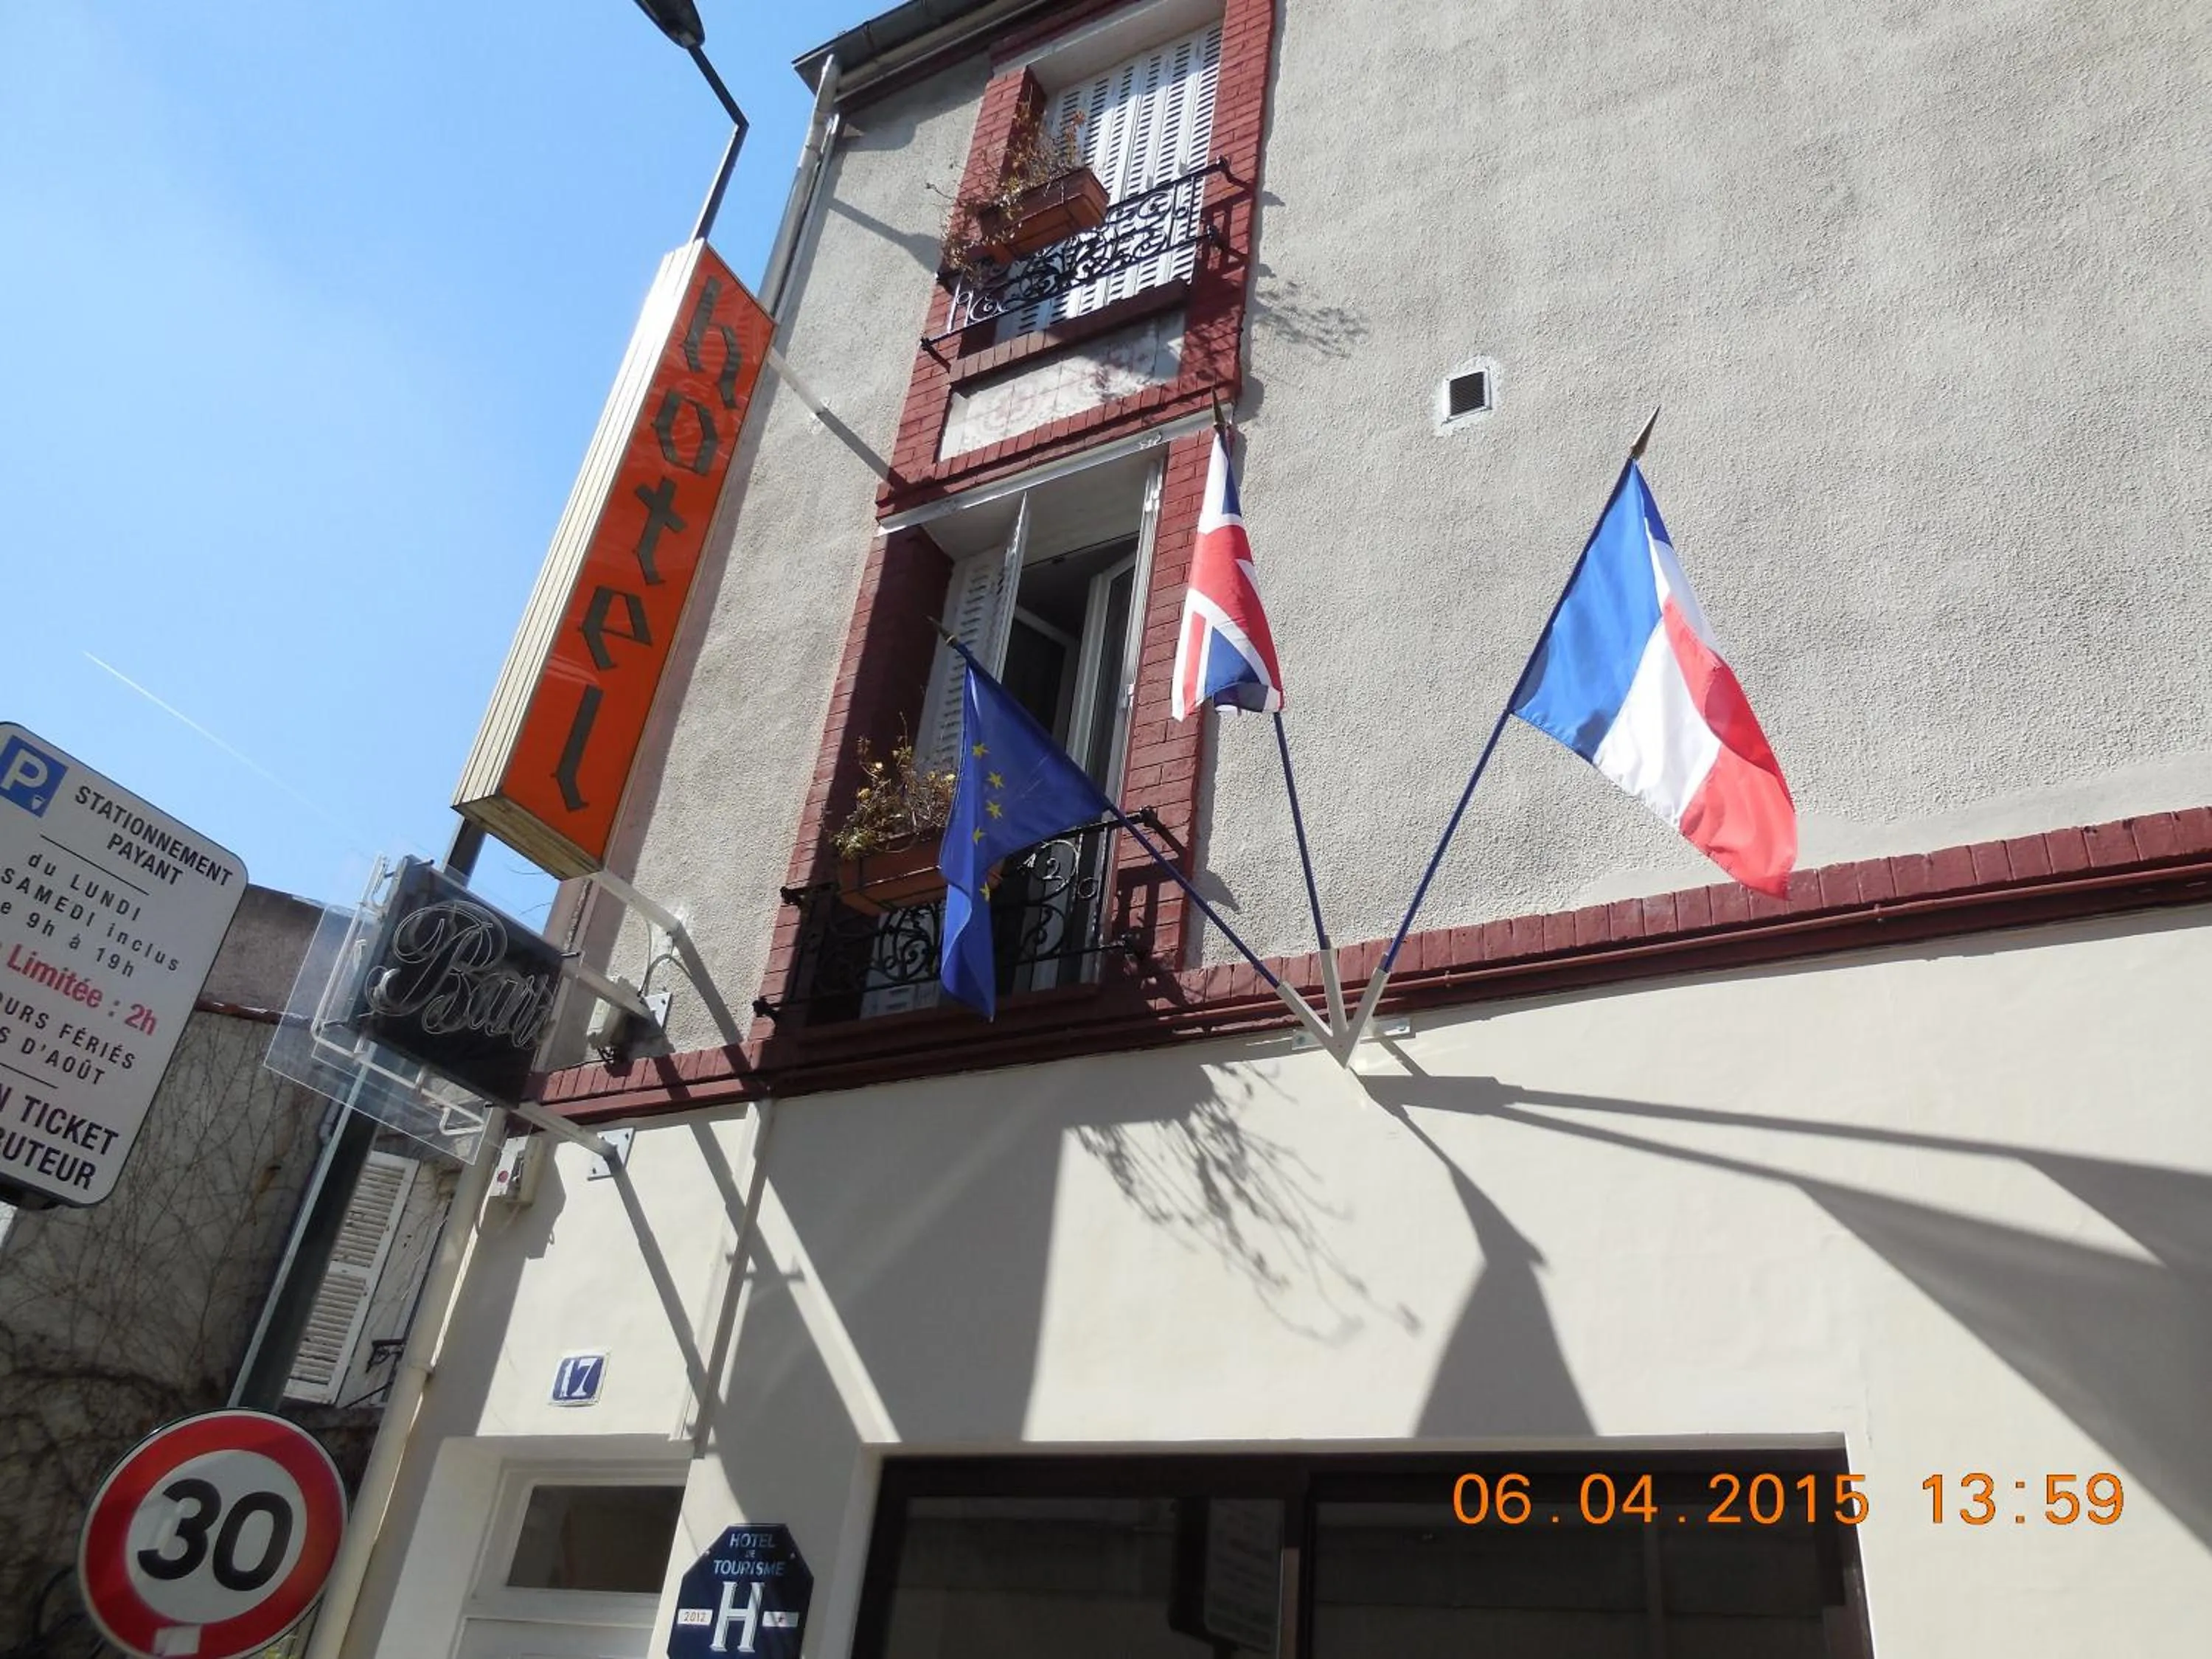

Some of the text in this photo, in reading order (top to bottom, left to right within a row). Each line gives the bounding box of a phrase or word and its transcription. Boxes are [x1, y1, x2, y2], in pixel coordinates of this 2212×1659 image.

[549, 275, 742, 813] hotel
[1, 748, 48, 790] P
[75, 785, 233, 886] STATIONNEMENT
[107, 833, 184, 886] PAYANT
[28, 854, 141, 921] du LUNDI
[1, 868, 179, 971] SAMEDI inclus
[27, 912, 55, 937] 9h
[97, 947, 134, 977] 19h
[7, 943, 103, 1008] Limitée
[124, 1003, 158, 1036] 2h
[21, 1037, 105, 1085] D'AOÛT
[59, 1023, 136, 1069] FÉRIÉS
[21, 1095, 119, 1155] TICKET
[558, 1357, 598, 1399] 17
[138, 1478, 293, 1591] 30
[729, 1533, 776, 1548] HOTEL
[714, 1559, 786, 1576] TOURISME
[684, 1581, 765, 1652] 2012 H
